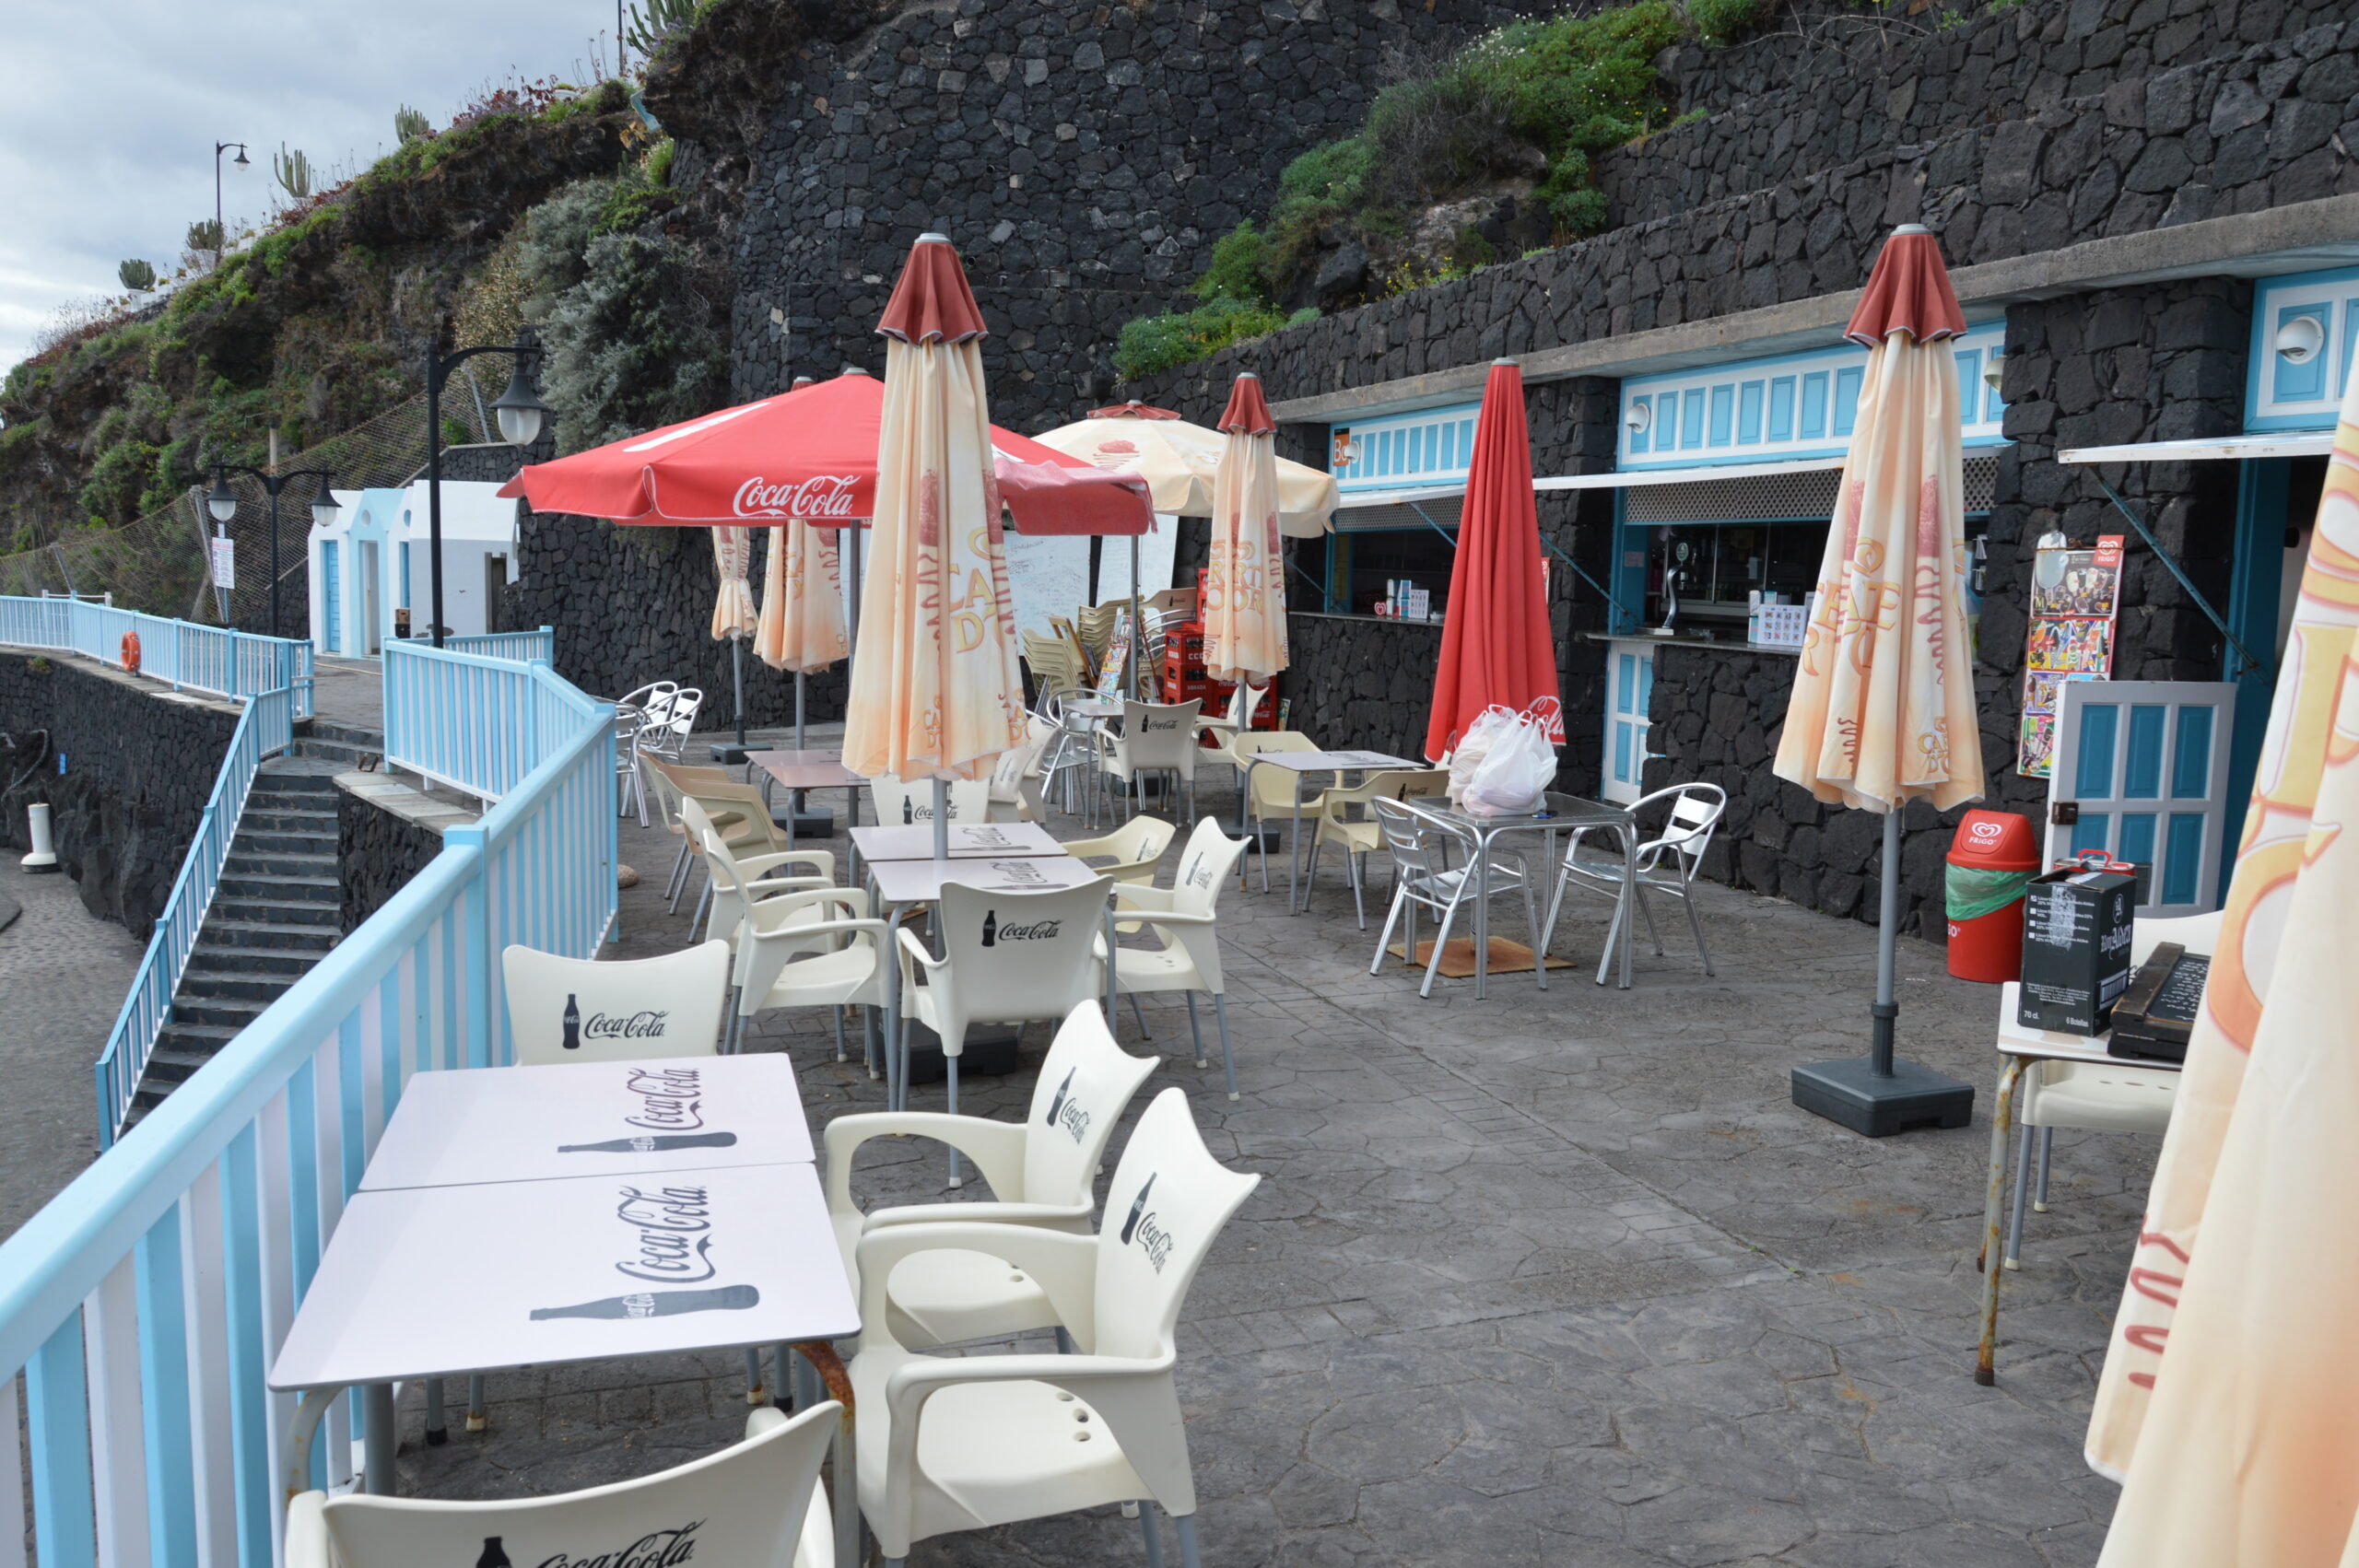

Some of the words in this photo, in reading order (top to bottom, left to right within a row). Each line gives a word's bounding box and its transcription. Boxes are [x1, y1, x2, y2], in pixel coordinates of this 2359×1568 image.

[733, 474, 863, 517] Coca-Cola
[1149, 720, 1179, 731] Coca-Cola
[998, 919, 1064, 942] Coca-Cola
[584, 1010, 670, 1039] Coca-Cola
[2024, 1010, 2032, 1019] 70
[624, 1067, 704, 1131] Coca-Cola
[1060, 1097, 1091, 1145] Coca-Cola
[616, 1185, 716, 1283] Coca-Cola
[1136, 1211, 1174, 1276] Coca-Cola
